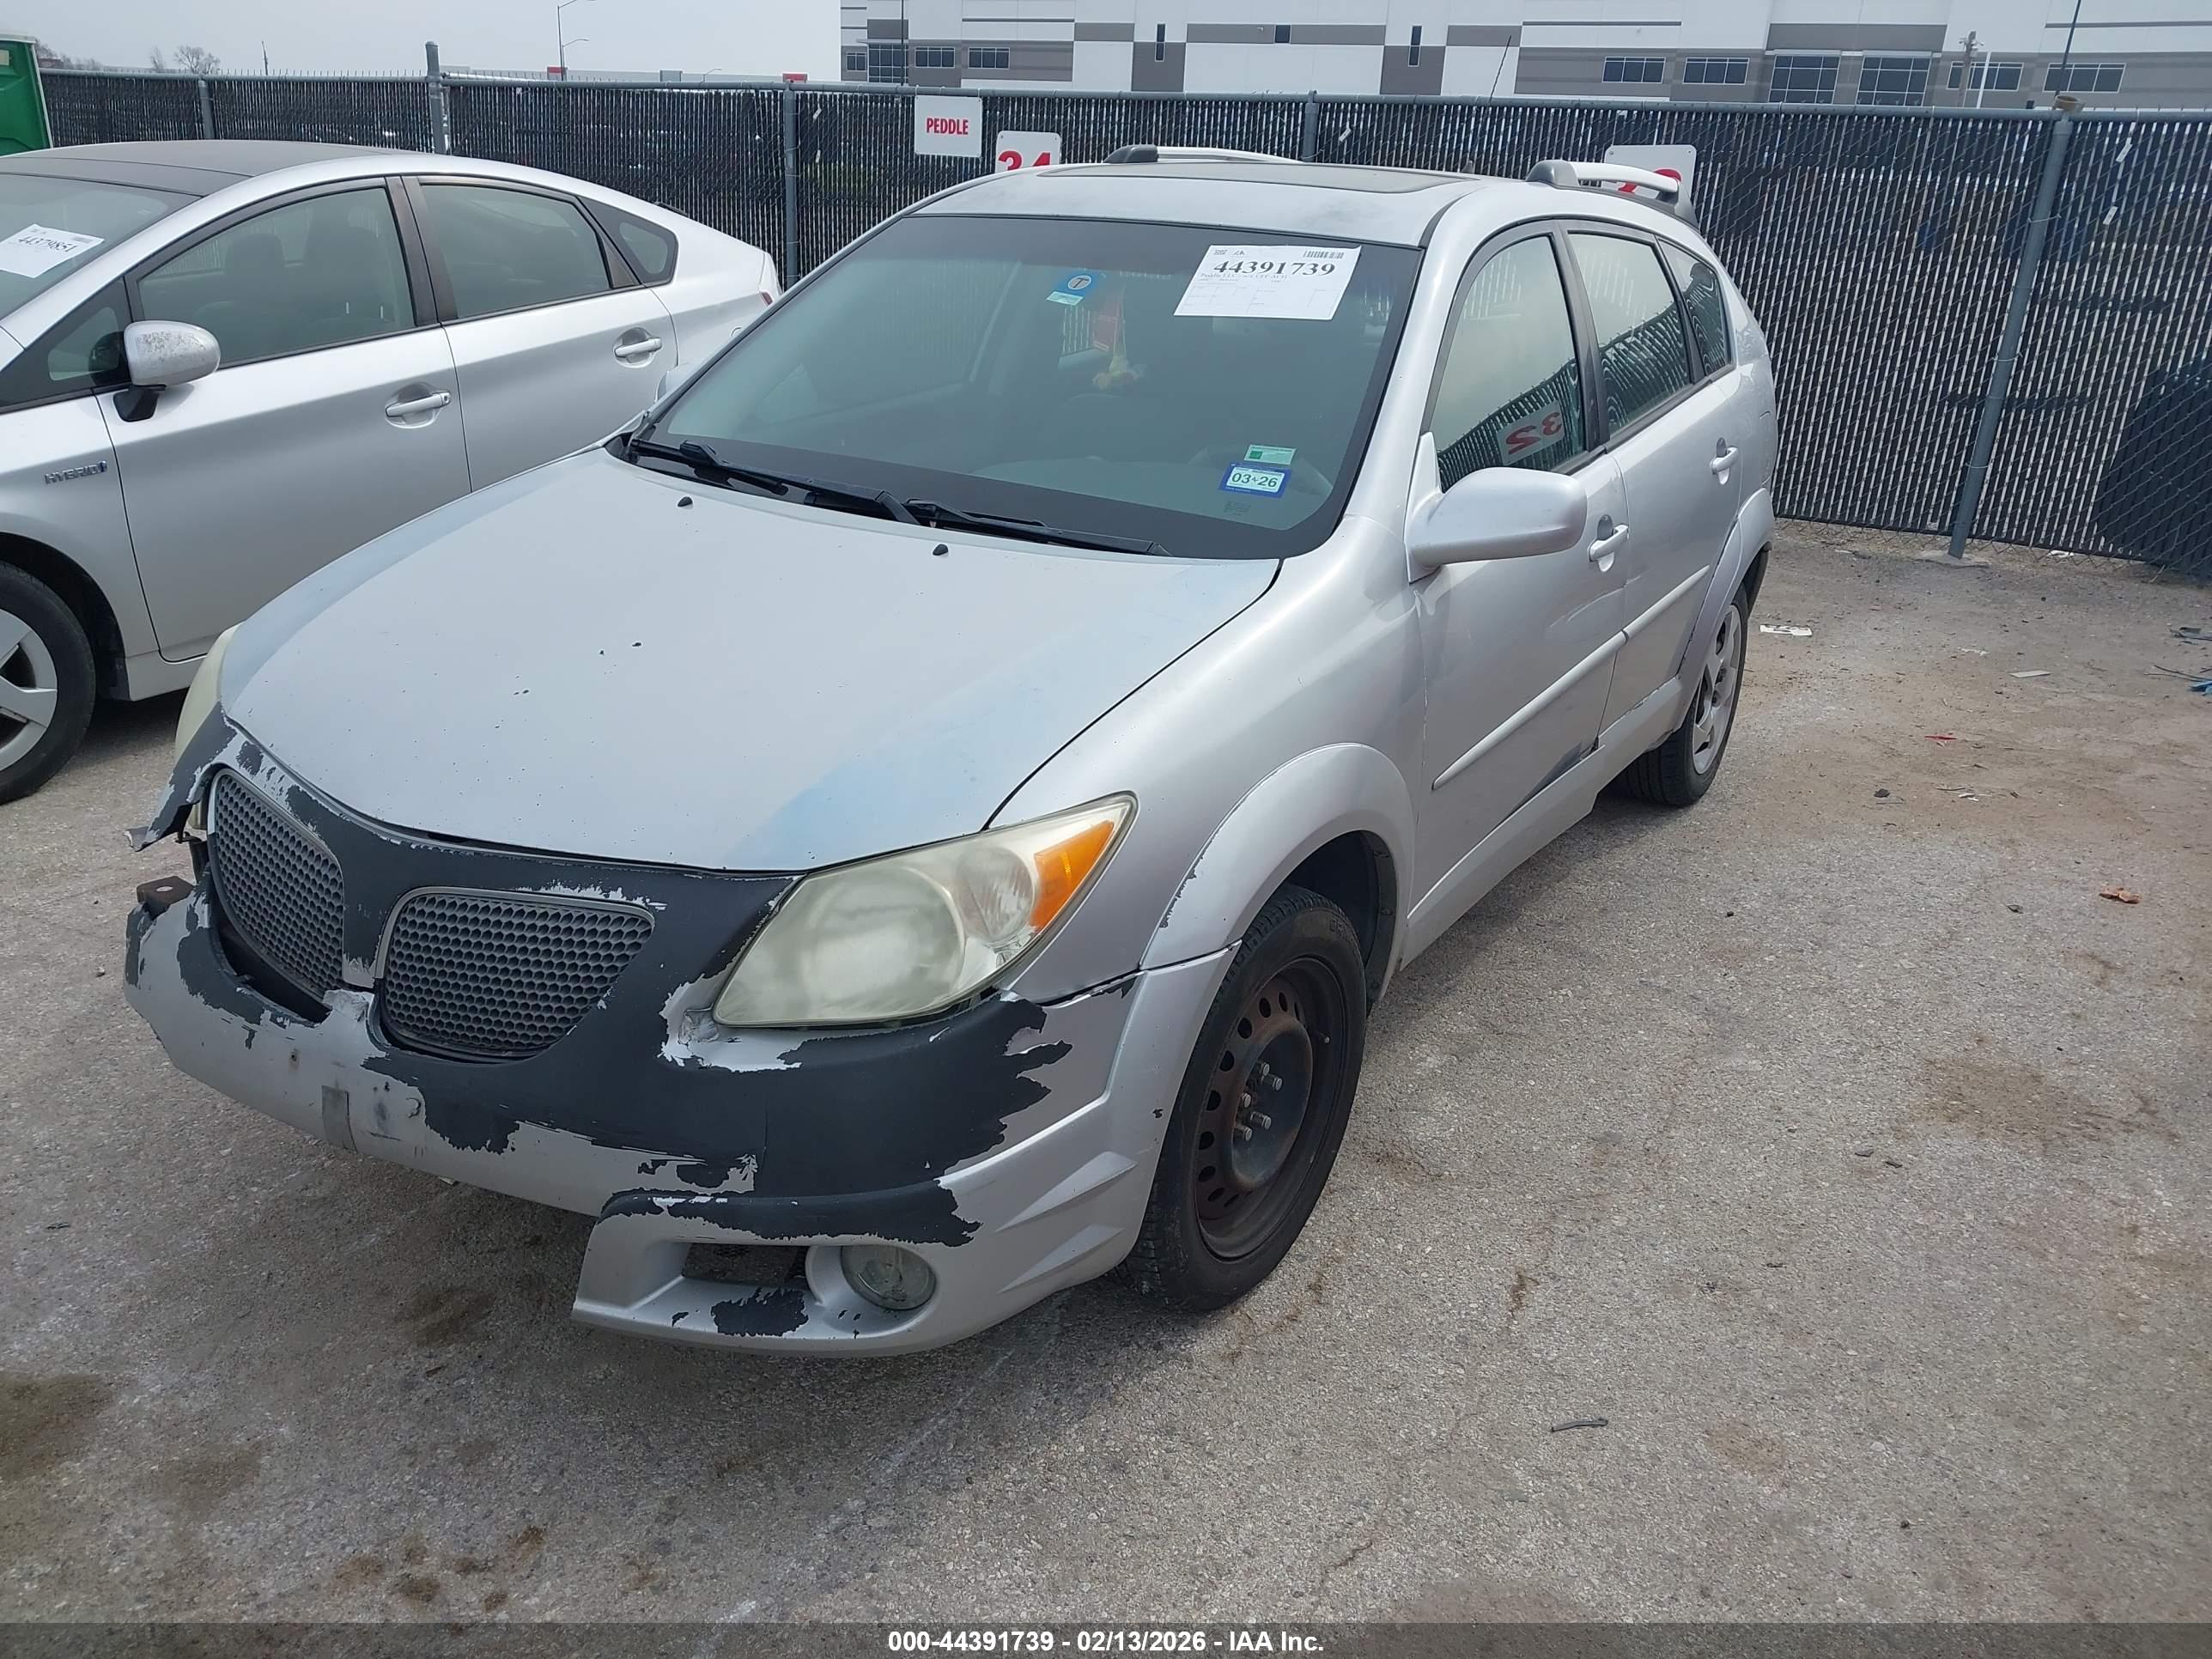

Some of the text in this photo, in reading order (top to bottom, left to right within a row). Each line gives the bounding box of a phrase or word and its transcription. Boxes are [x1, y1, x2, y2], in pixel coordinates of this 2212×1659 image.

[927, 118, 969, 135] PEDDLE
[1213, 261, 1335, 276] 44391739
[45, 465, 96, 484] HYBRID
